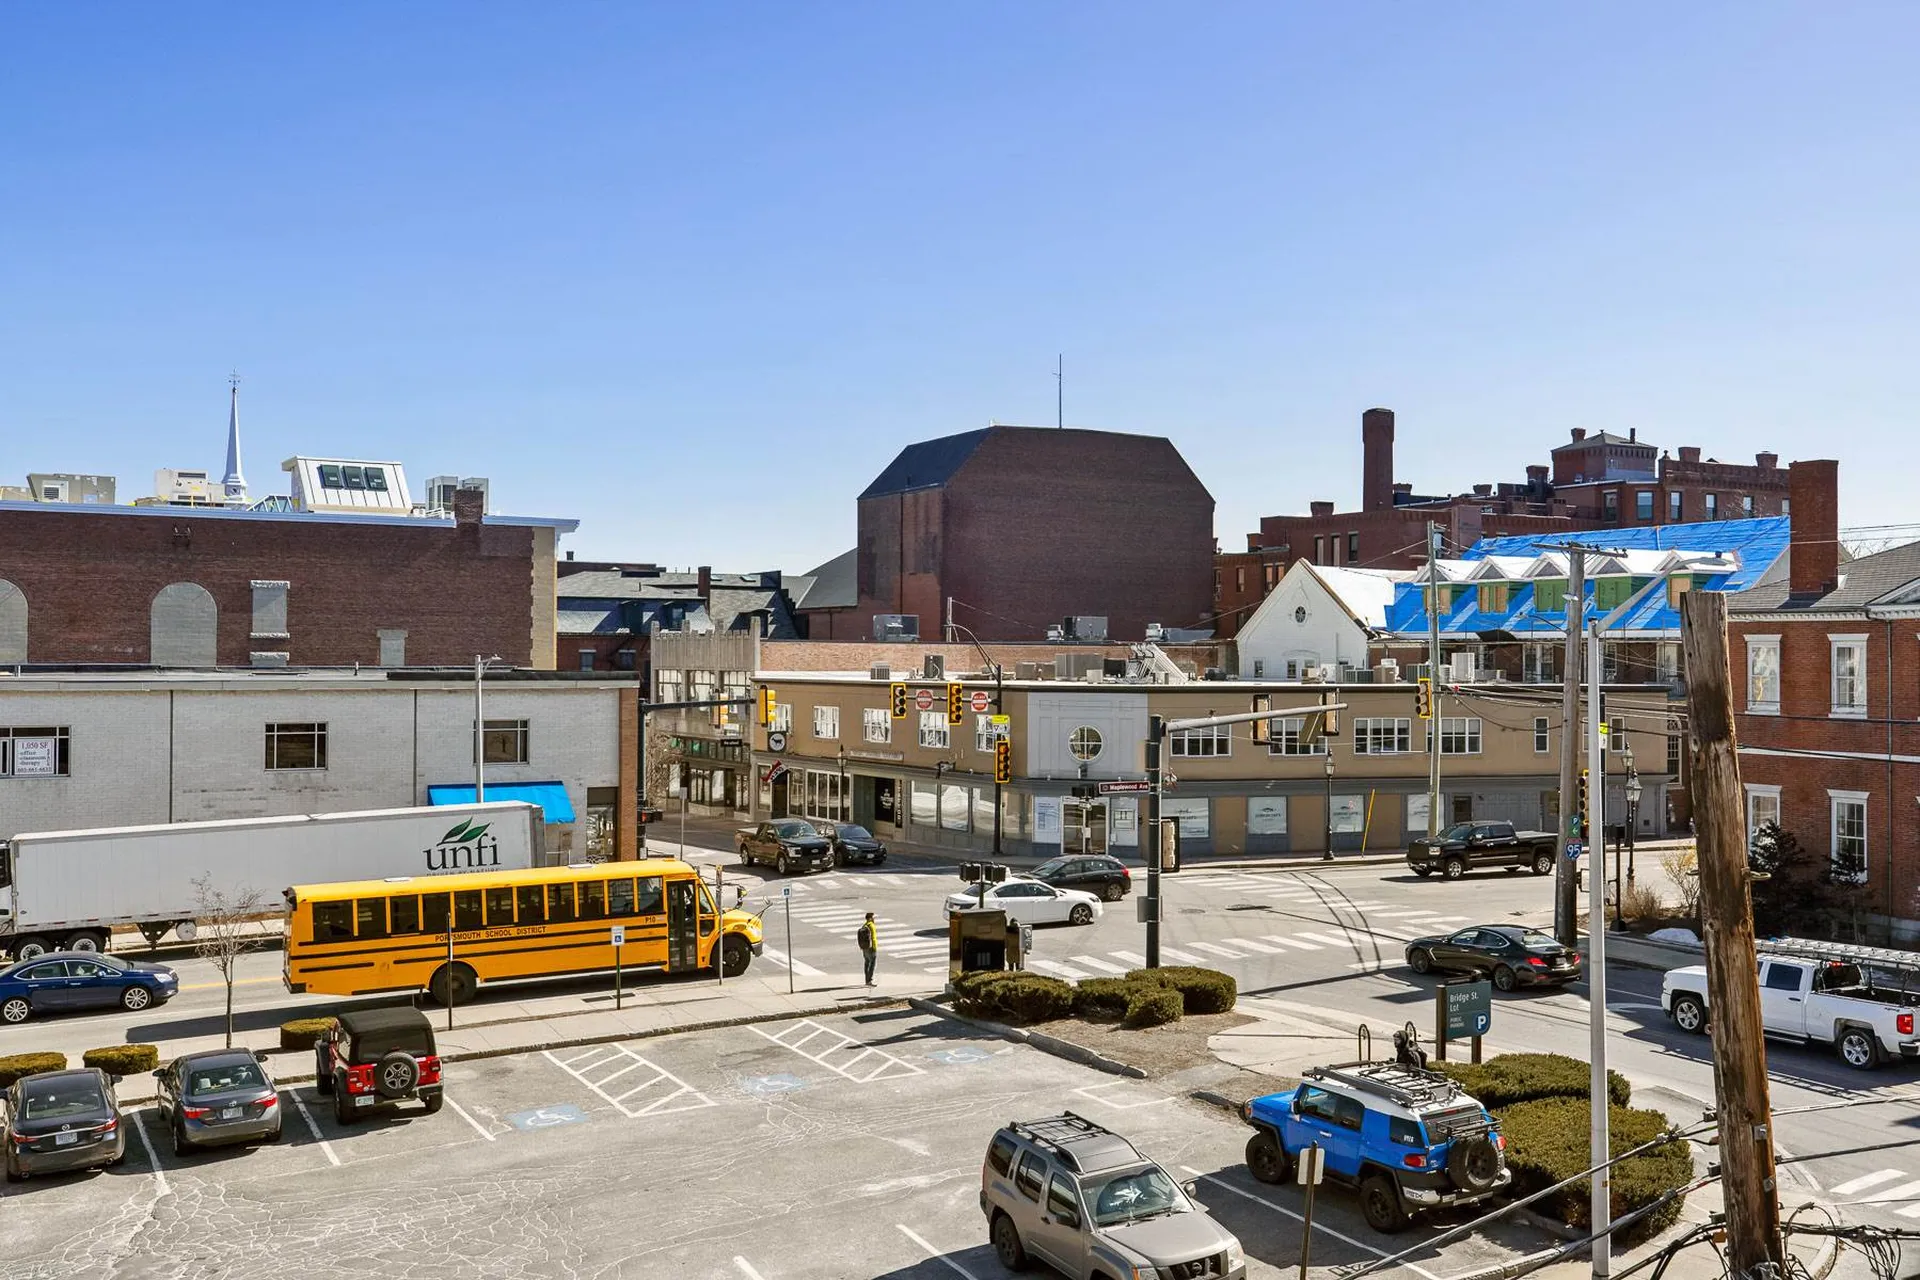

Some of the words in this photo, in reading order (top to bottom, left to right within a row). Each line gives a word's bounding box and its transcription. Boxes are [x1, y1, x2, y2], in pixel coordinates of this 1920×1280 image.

[21, 741, 39, 750] 1,050
[1110, 783, 1138, 793] Maplewood
[1139, 783, 1149, 791] Ave
[422, 833, 501, 871] unfi
[1567, 844, 1580, 856] 95
[485, 928, 511, 938] SCHOOL
[516, 925, 547, 936] DISTRICT
[1449, 992, 1470, 1003] Bridge
[1471, 991, 1479, 1000] St.
[1449, 1003, 1460, 1012] Lot
[1477, 1014, 1487, 1030] P
